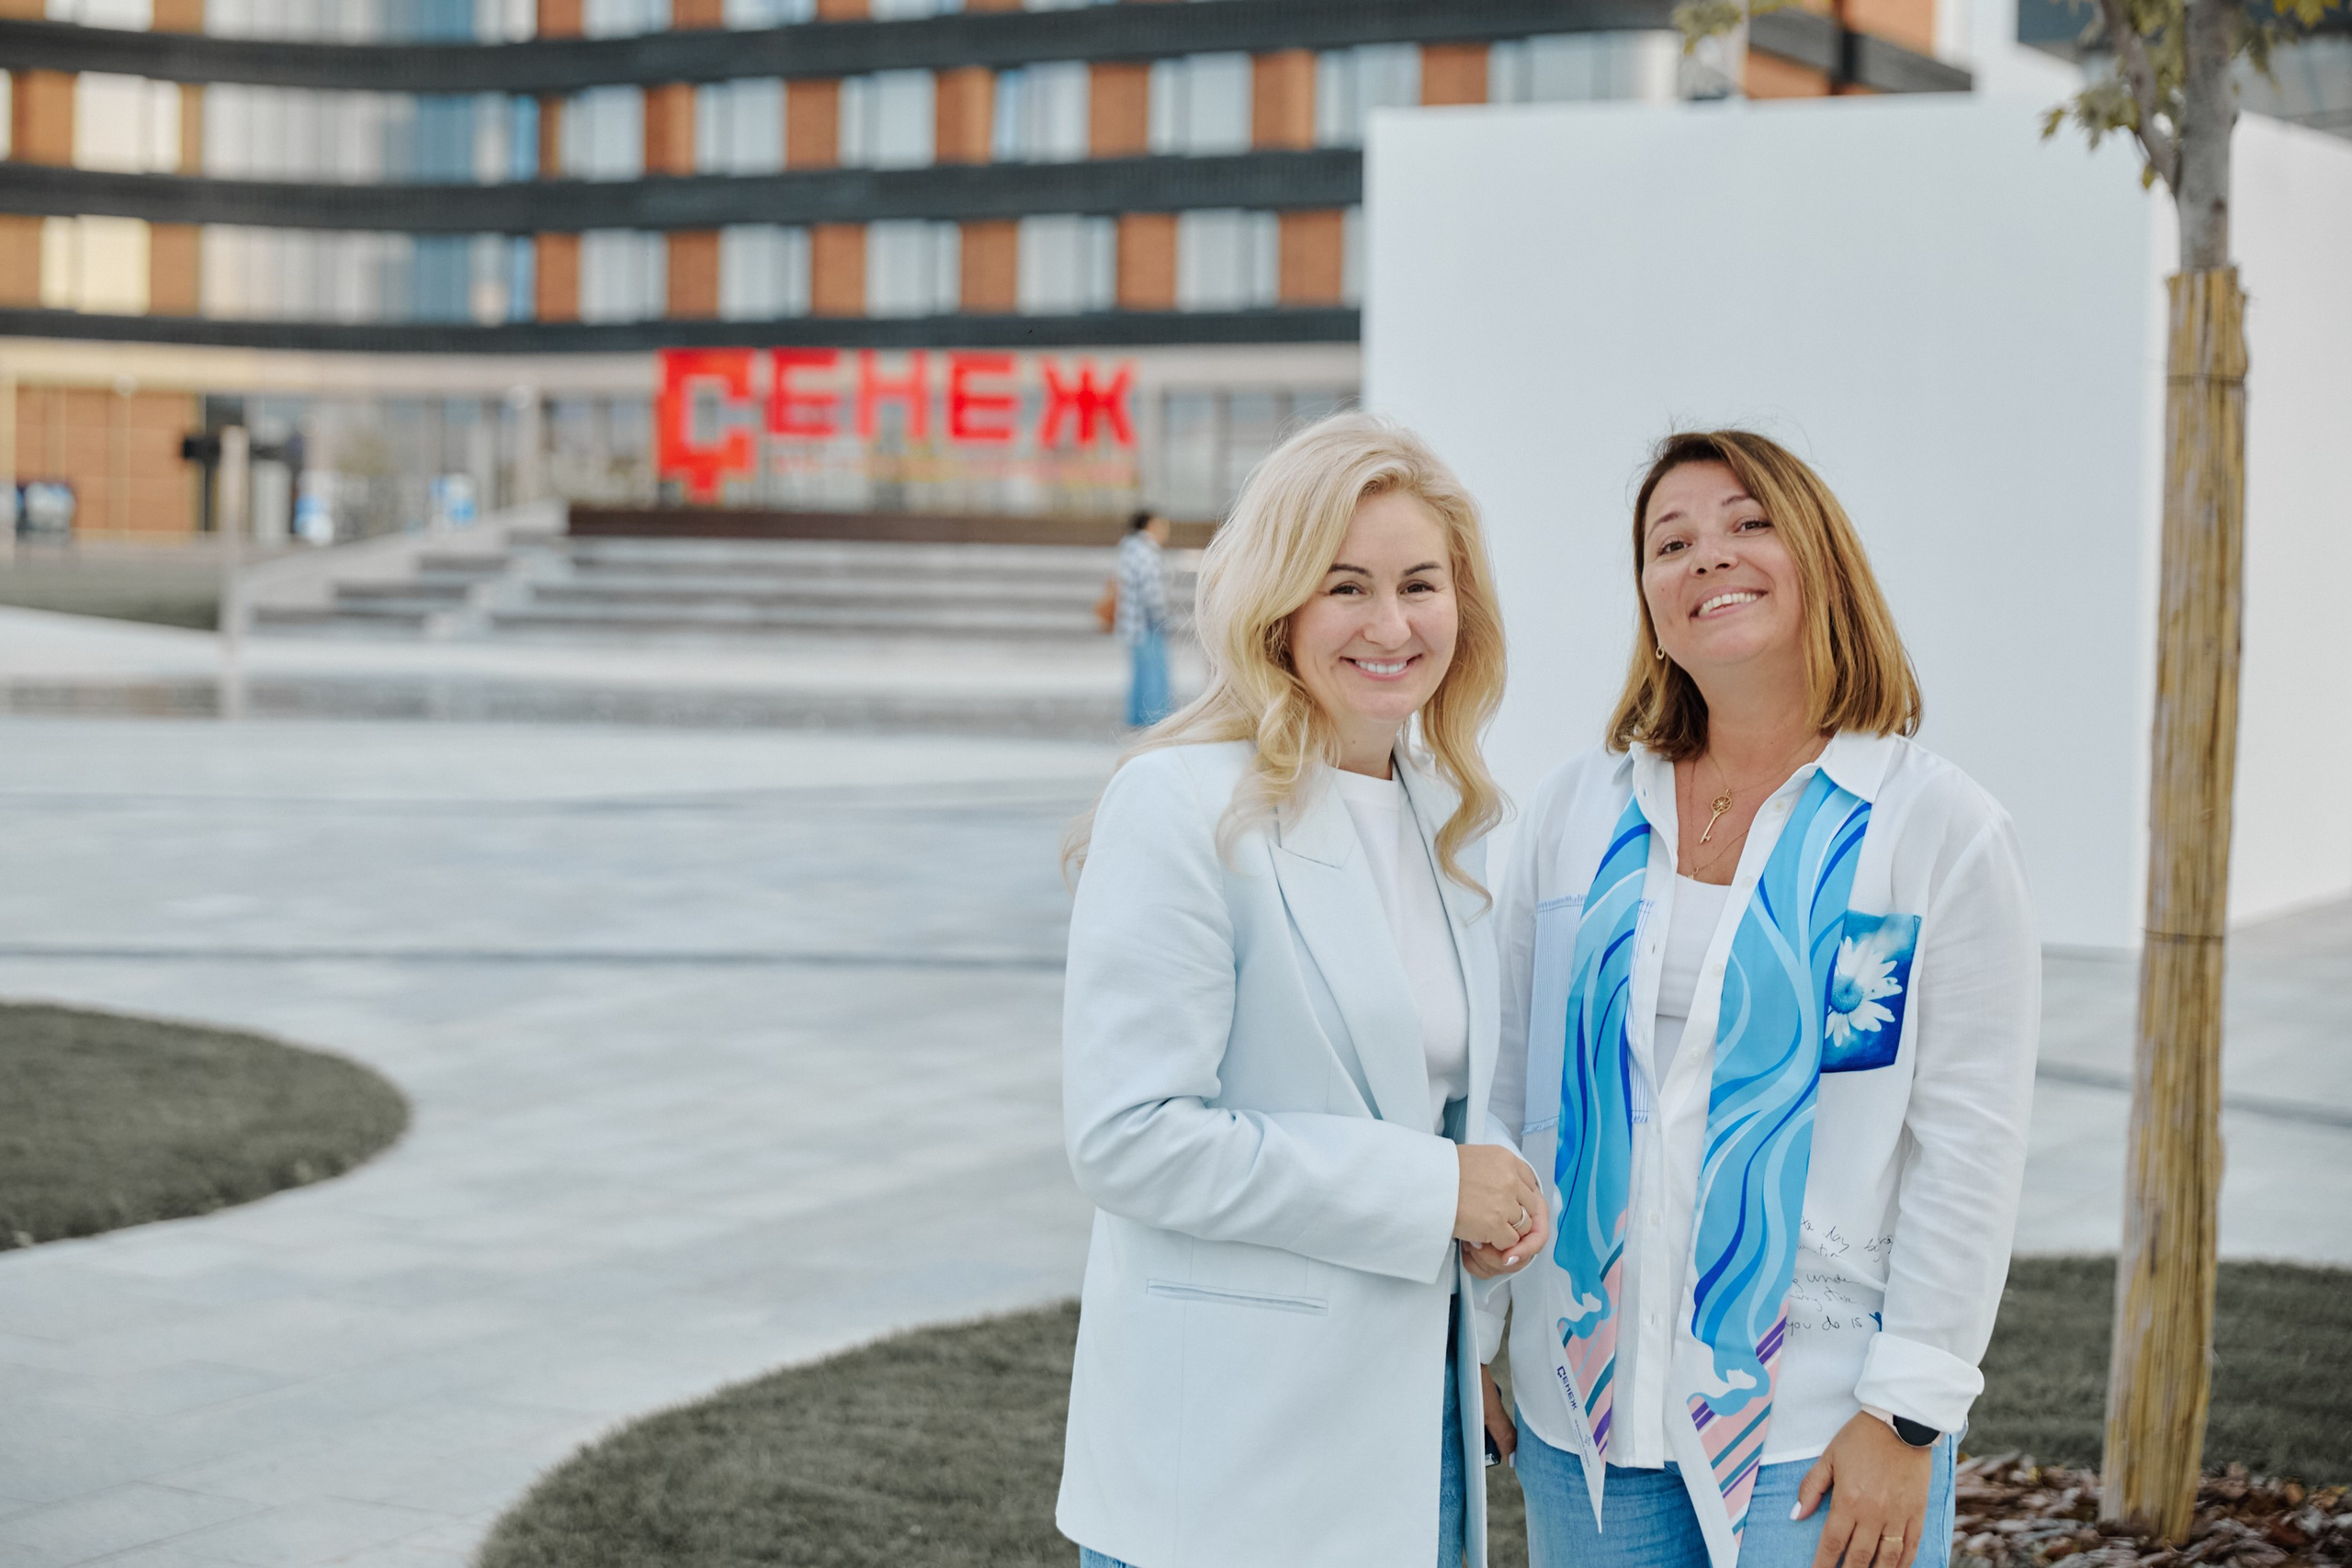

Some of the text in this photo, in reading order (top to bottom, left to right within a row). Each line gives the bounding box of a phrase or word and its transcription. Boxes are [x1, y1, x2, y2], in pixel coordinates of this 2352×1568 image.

[657, 346, 1138, 503] СЕНЕЖ
[1785, 1321, 1812, 1337] you
[1822, 1315, 1840, 1331] do
[1556, 1365, 1578, 1411] СЕНЕЖ
